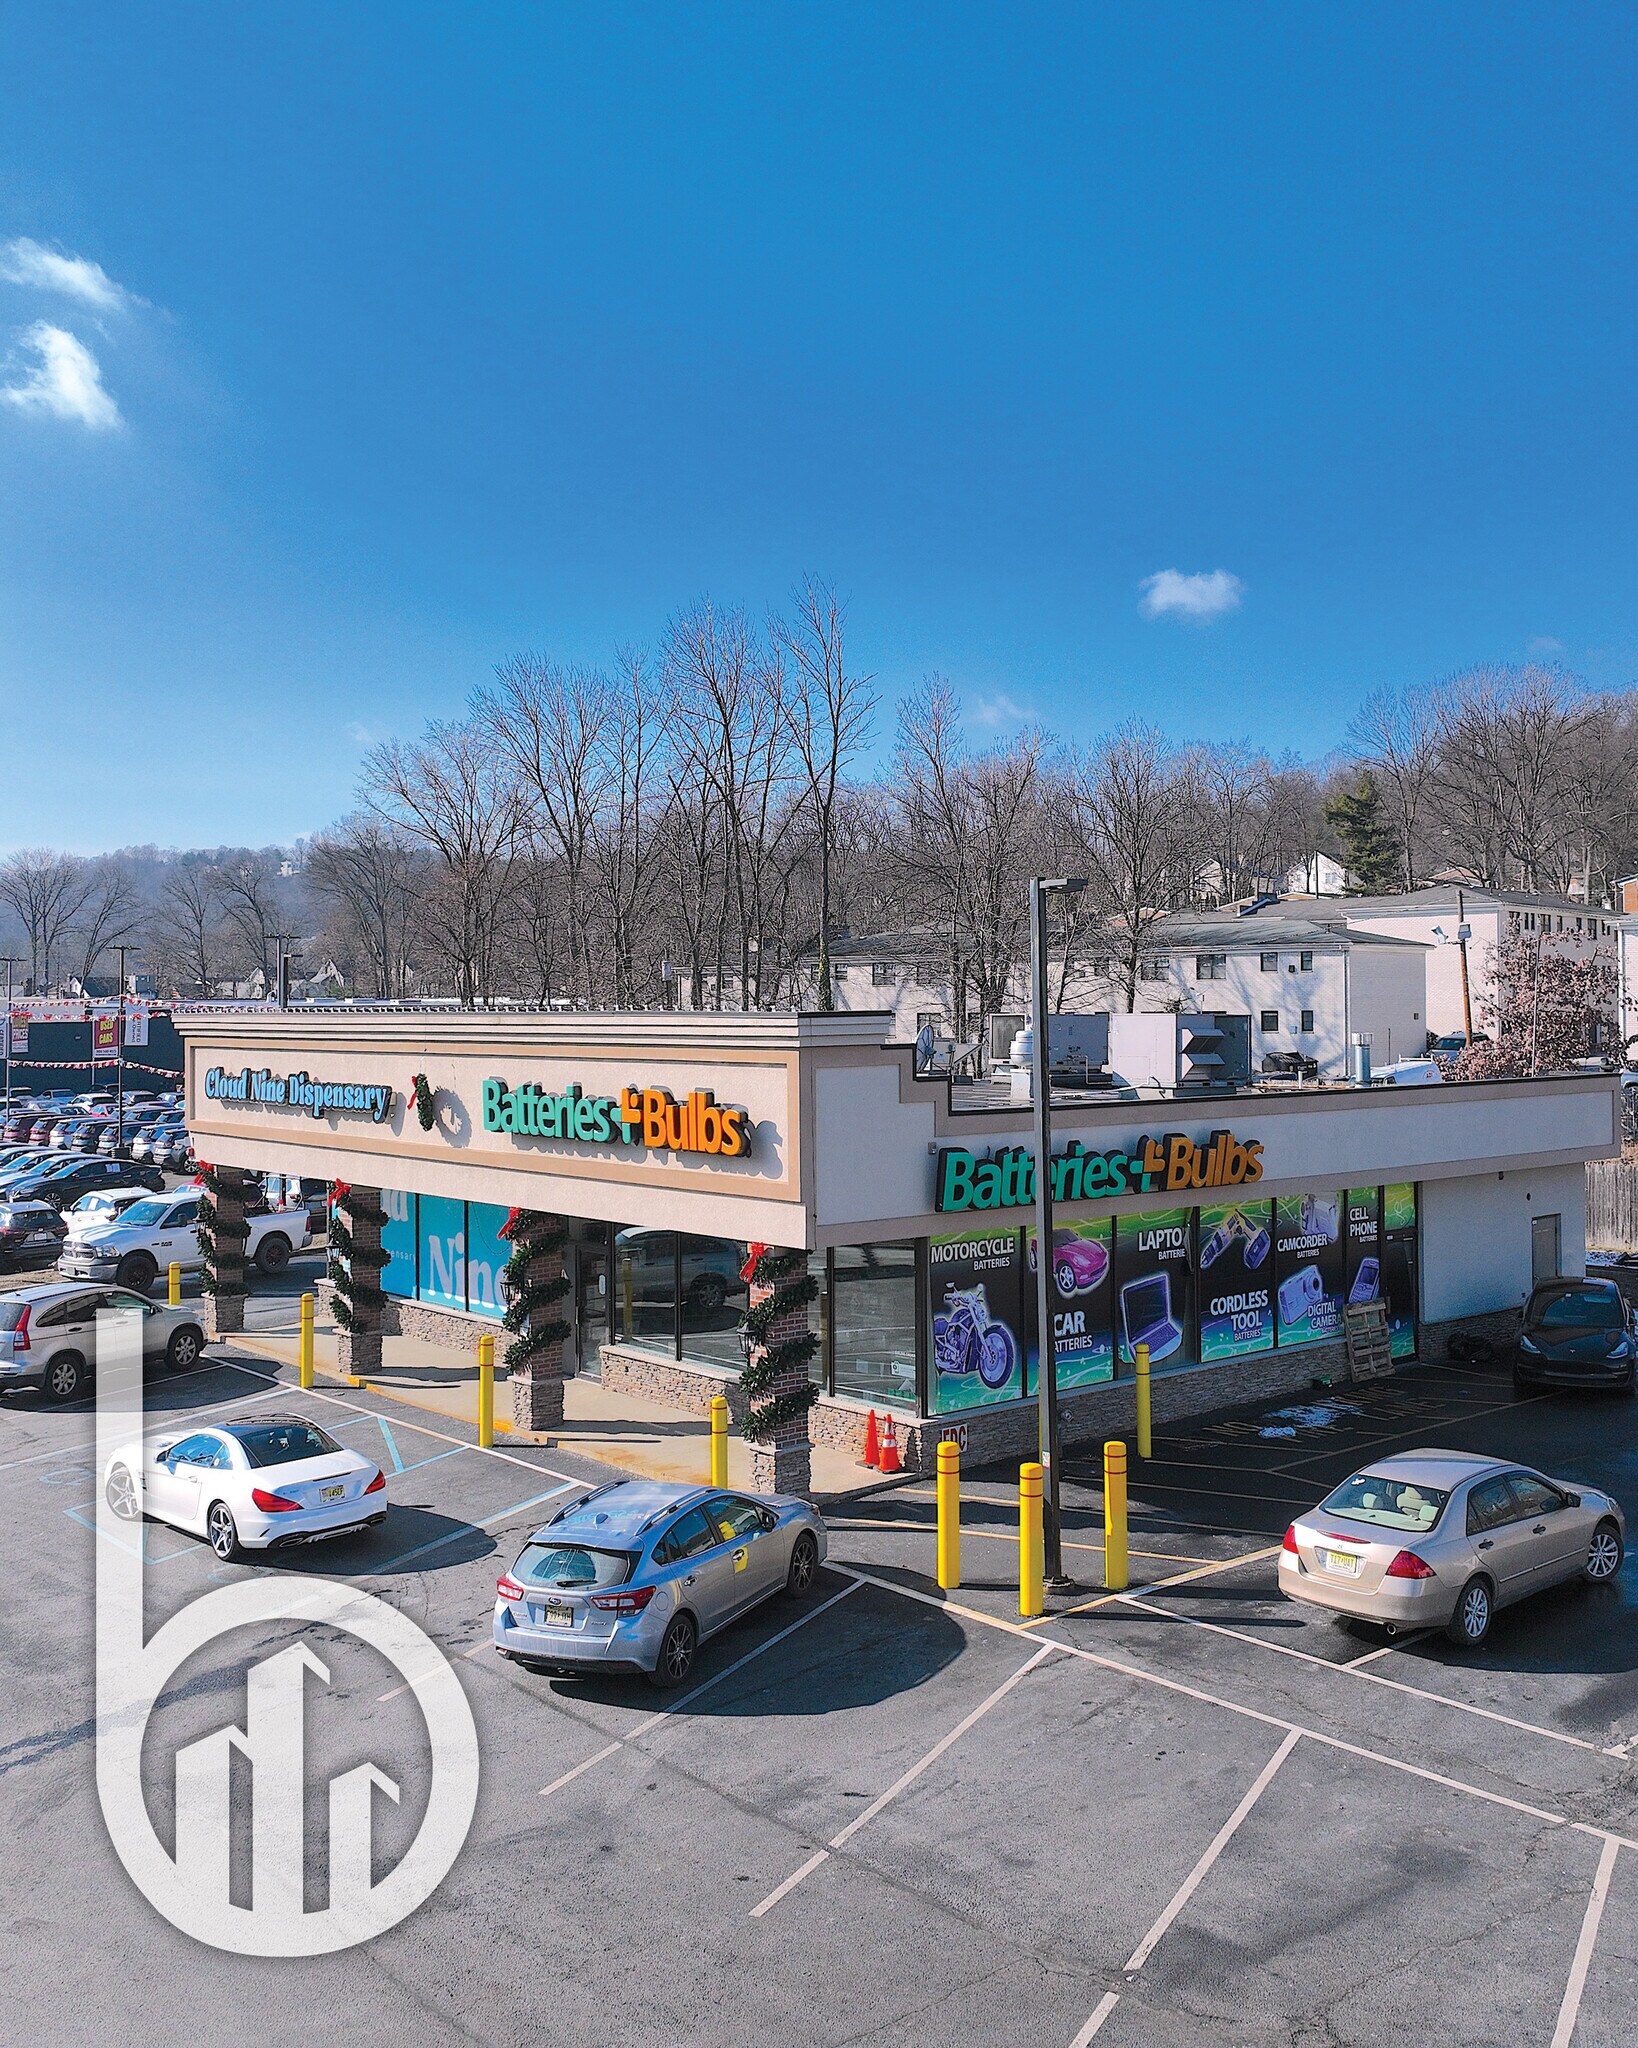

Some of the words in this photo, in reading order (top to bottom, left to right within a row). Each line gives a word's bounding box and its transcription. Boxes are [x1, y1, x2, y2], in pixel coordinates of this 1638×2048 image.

[205, 1067, 249, 1099] Cloud
[251, 1069, 286, 1104] Nine
[288, 1072, 390, 1122] Dispensary
[482, 1079, 611, 1143] Batteries
[643, 1089, 743, 1156] Bulbs
[1166, 1132, 1265, 1191] Bulbs
[1349, 1206, 1369, 1221] CELL
[1138, 1227, 1183, 1252] LAPTO
[1349, 1221, 1378, 1237] PHONE
[930, 1237, 1015, 1263] MOTORCYCLE
[1277, 1233, 1329, 1253] CAMCORDER
[1296, 1247, 1320, 1259] BATTERIES
[973, 1256, 1010, 1271] BATTERIES
[1210, 1289, 1269, 1316] CORDLESS
[1307, 1300, 1337, 1317] DIGITAL
[1054, 1310, 1086, 1337] CAR
[1231, 1310, 1262, 1332] TOOL
[1310, 1314, 1342, 1329] CAMERA
[1233, 1329, 1261, 1342] BATTERIES
